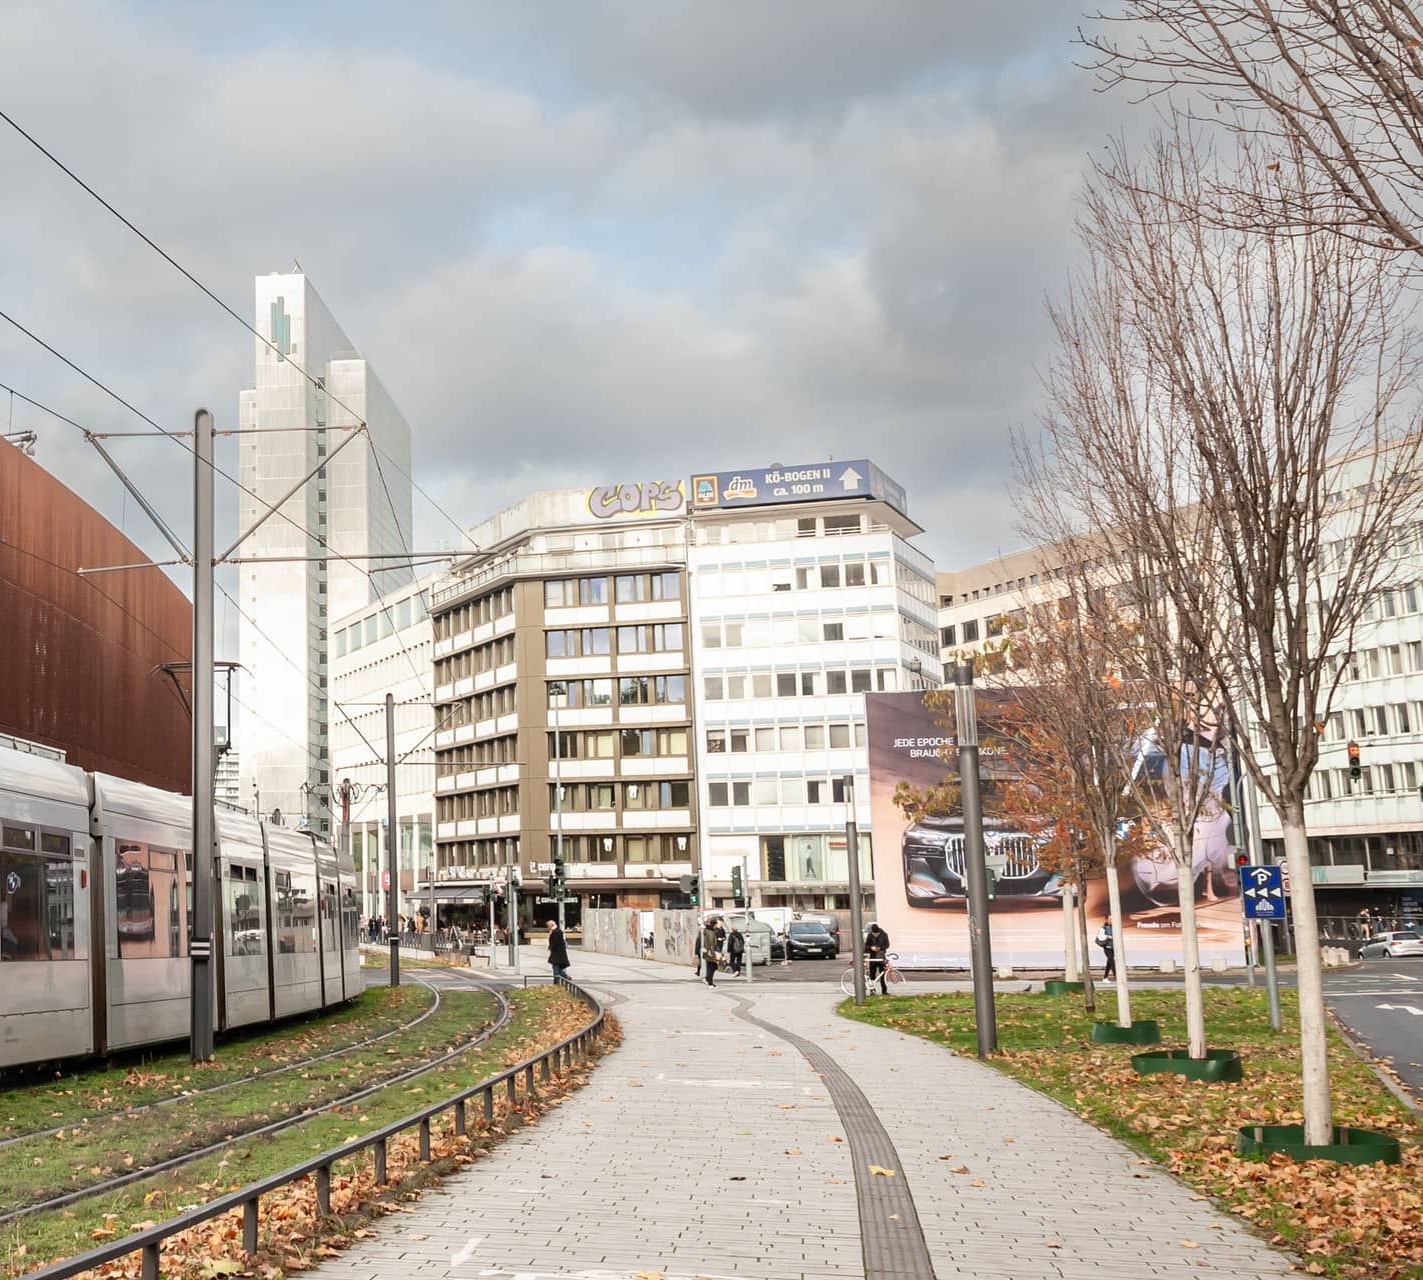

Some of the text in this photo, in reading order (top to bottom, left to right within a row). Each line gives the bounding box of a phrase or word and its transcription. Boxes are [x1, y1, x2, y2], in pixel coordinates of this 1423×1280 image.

[764, 468, 820, 484] KÖ-BOGEN
[728, 476, 754, 491] dm
[773, 484, 824, 497] ca. 100 m
[589, 480, 684, 519] COPS
[893, 736, 954, 748] JEDE EPOCHE
[1257, 873, 1267, 885] P
